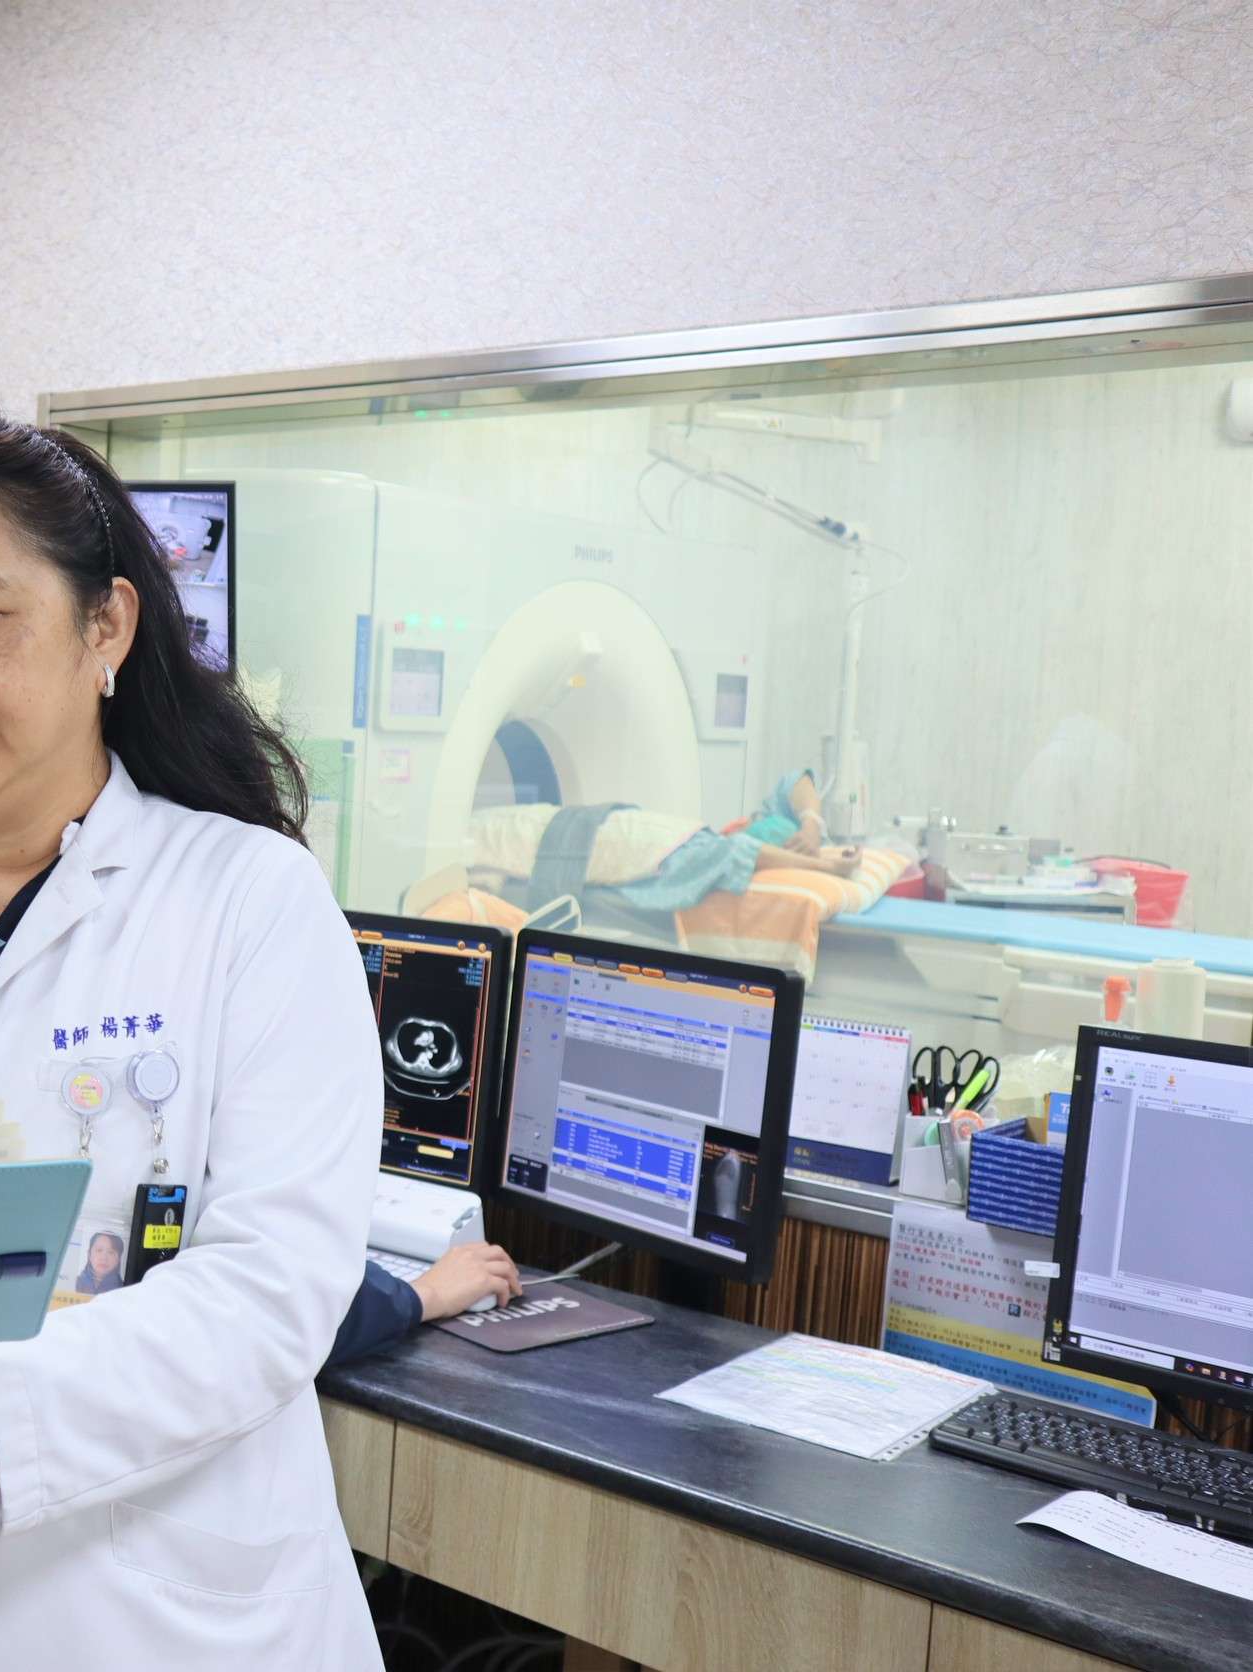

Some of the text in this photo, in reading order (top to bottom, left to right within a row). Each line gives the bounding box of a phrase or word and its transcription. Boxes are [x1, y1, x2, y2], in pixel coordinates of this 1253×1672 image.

[52, 1013, 164, 1051] 醫師 楊菁華
[456, 1296, 581, 1327] PHILIPS
